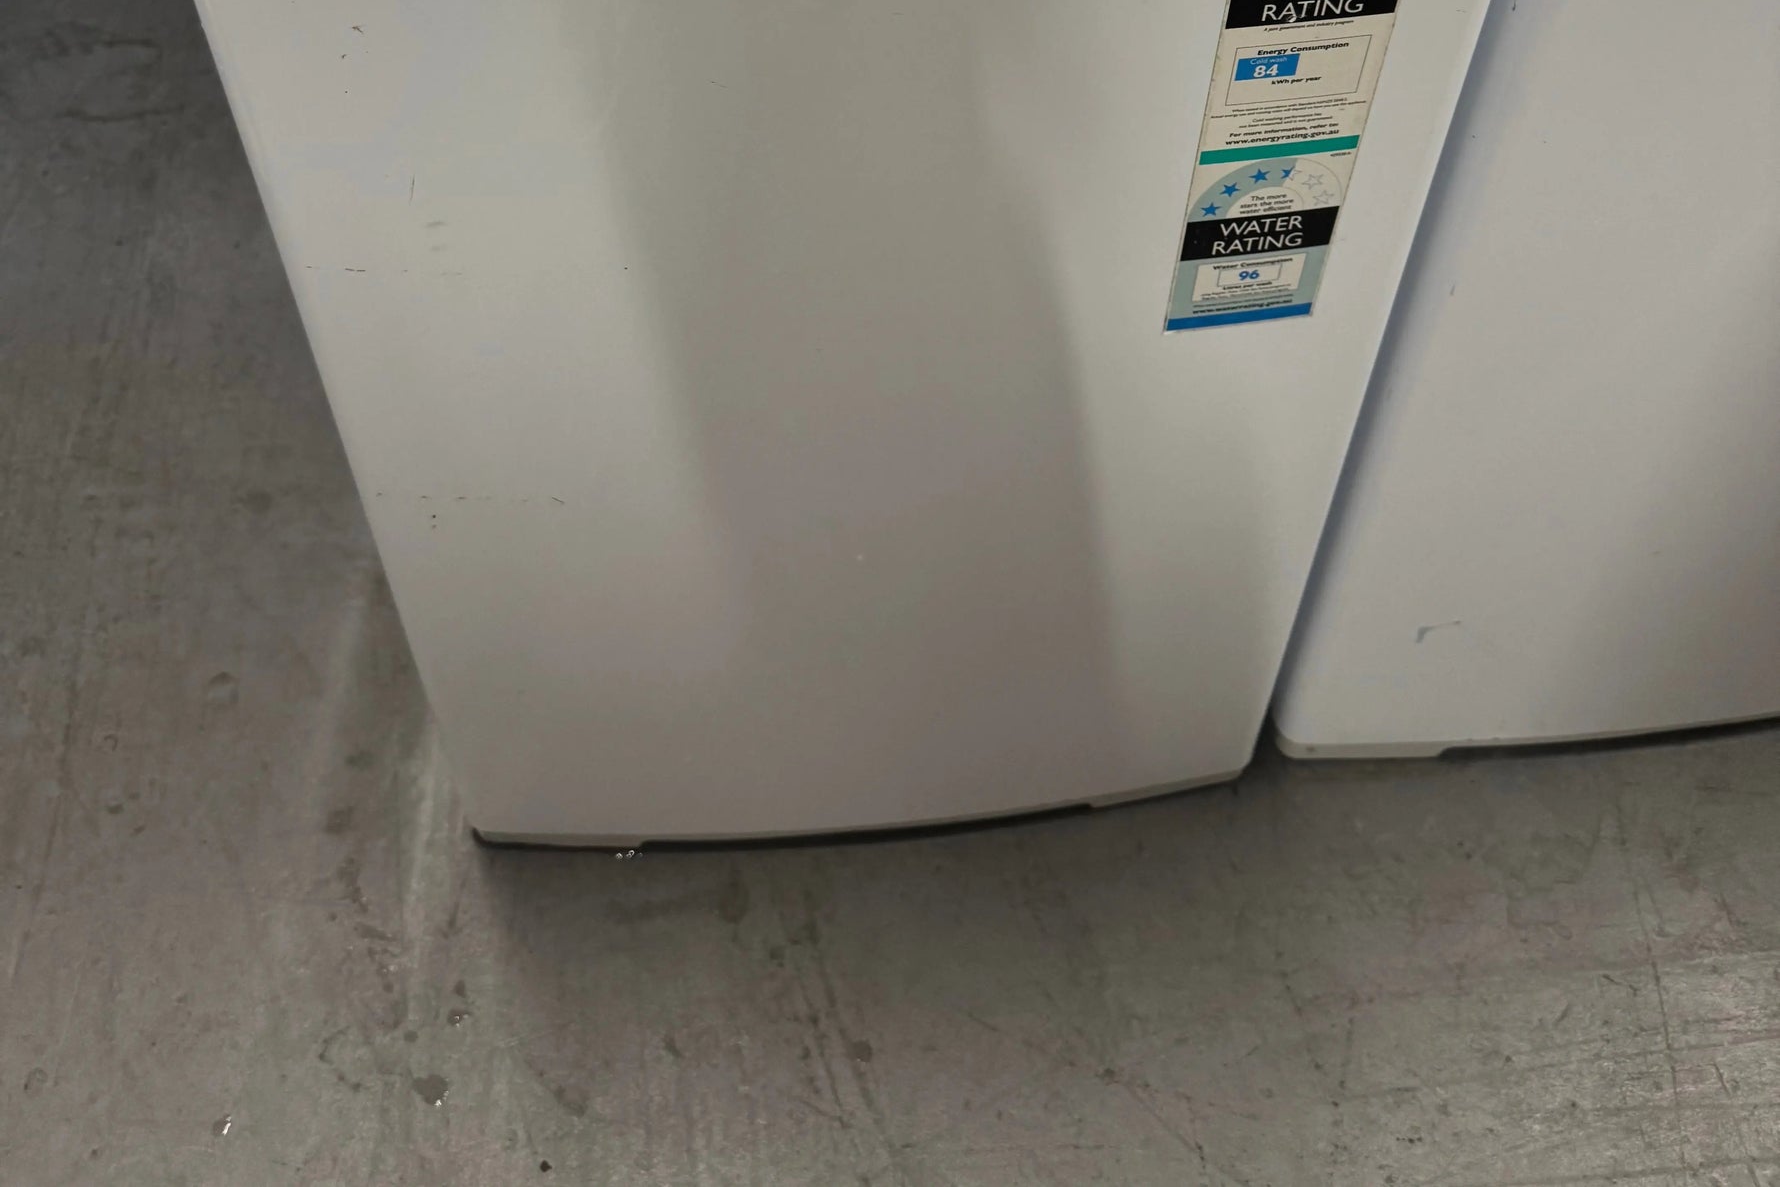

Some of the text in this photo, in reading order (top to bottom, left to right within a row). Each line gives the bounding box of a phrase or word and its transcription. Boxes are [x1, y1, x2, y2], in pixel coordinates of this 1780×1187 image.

[1257, 42, 1349, 56] Energy Consumption
[1250, 57, 1268, 65] Cold
[1253, 64, 1279, 78] 84
[1264, 125, 1308, 134] information,
[1225, 129, 1339, 145] www.energyrating.gov.au
[1220, 215, 1303, 236] WATER
[1212, 232, 1304, 255] RATING
[1238, 270, 1260, 281] 96
